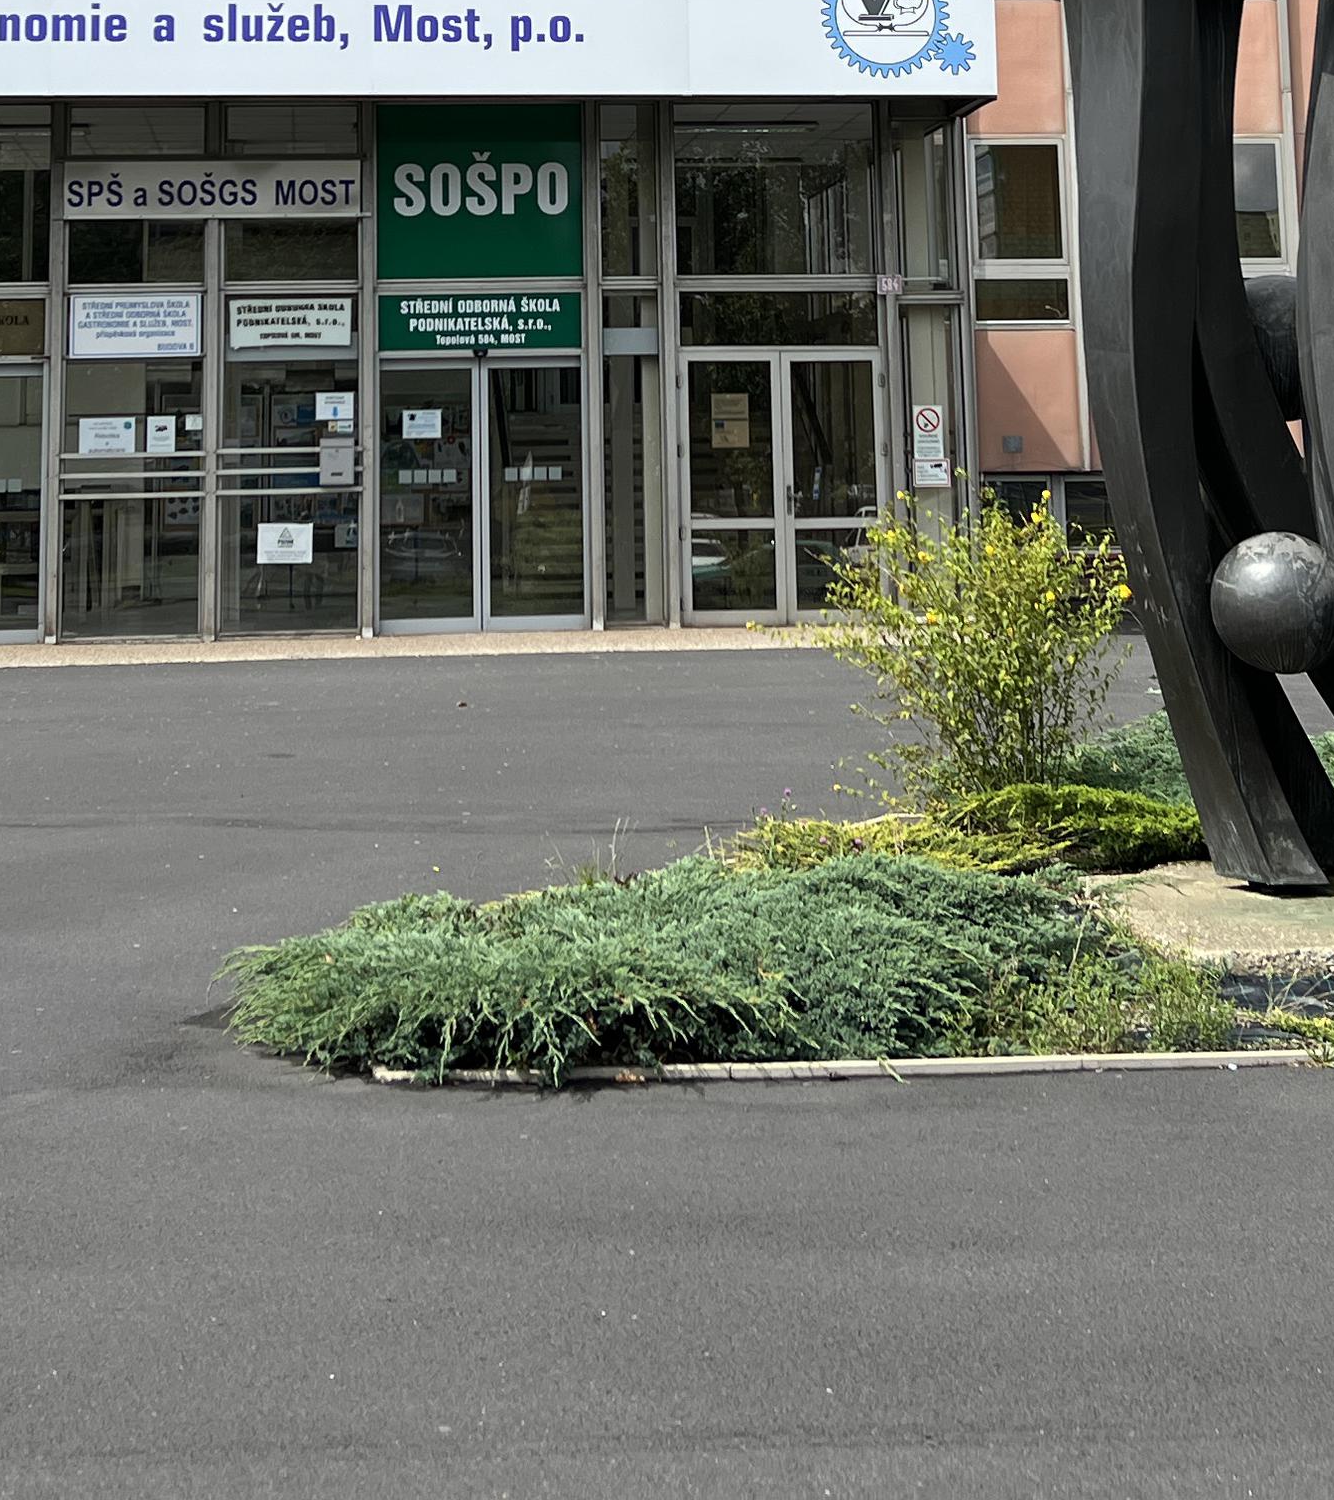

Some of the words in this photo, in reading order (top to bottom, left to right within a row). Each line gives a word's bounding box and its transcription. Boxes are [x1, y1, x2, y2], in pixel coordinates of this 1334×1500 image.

[153, 14, 175, 42] a
[203, 3, 349, 50] služeb,
[373, 4, 493, 50] Most,
[510, 15, 584, 51] p.o.
[67, 173, 123, 207] SPŠ
[133, 187, 148, 206] a
[158, 172, 258, 206] SOŠGS
[275, 179, 356, 206] MOST
[393, 152, 569, 217] SOŠPO
[881, 276, 899, 292] 584
[400, 297, 453, 314] STŘEDNÍ
[457, 296, 517, 314] ODBORNÁ
[520, 296, 561, 312] ŠKOLA
[409, 315, 513, 332] PODNIKATELSKÁ,
[500, 333, 526, 344] MOST
